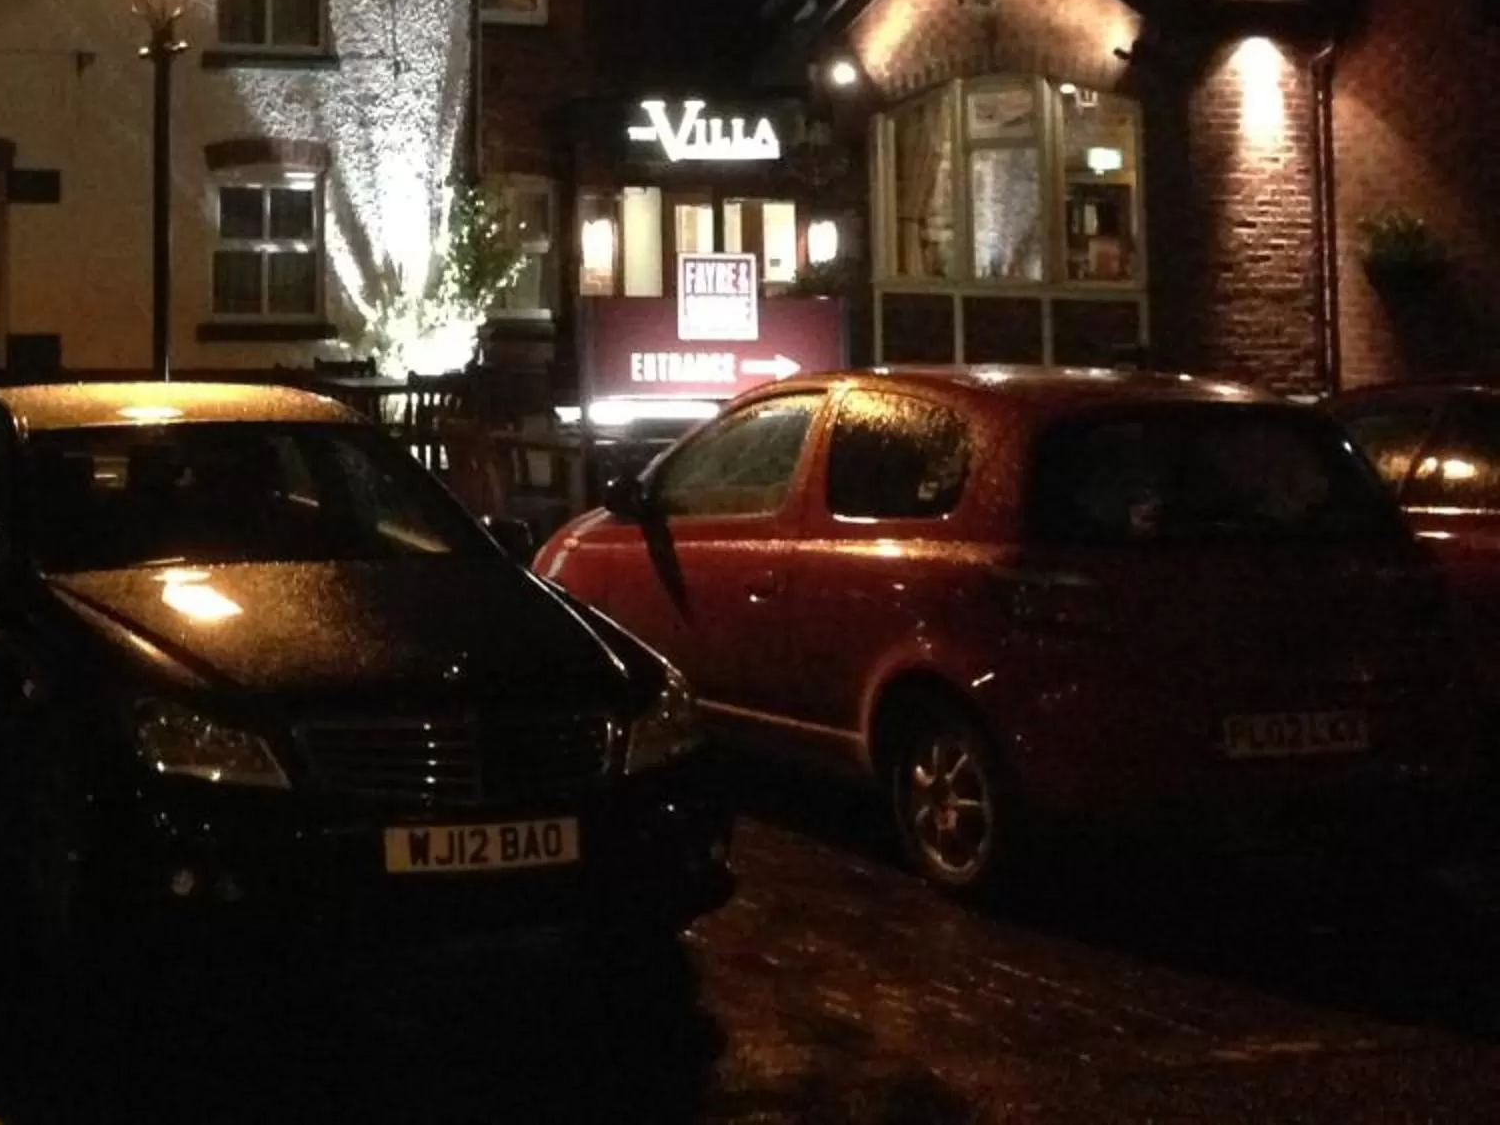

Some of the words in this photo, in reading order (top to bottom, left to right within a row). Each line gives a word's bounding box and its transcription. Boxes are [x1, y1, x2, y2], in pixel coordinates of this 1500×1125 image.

[641, 100, 781, 161] VILLA
[631, 352, 737, 383] ENTRANCE
[408, 828, 489, 866] WJ12
